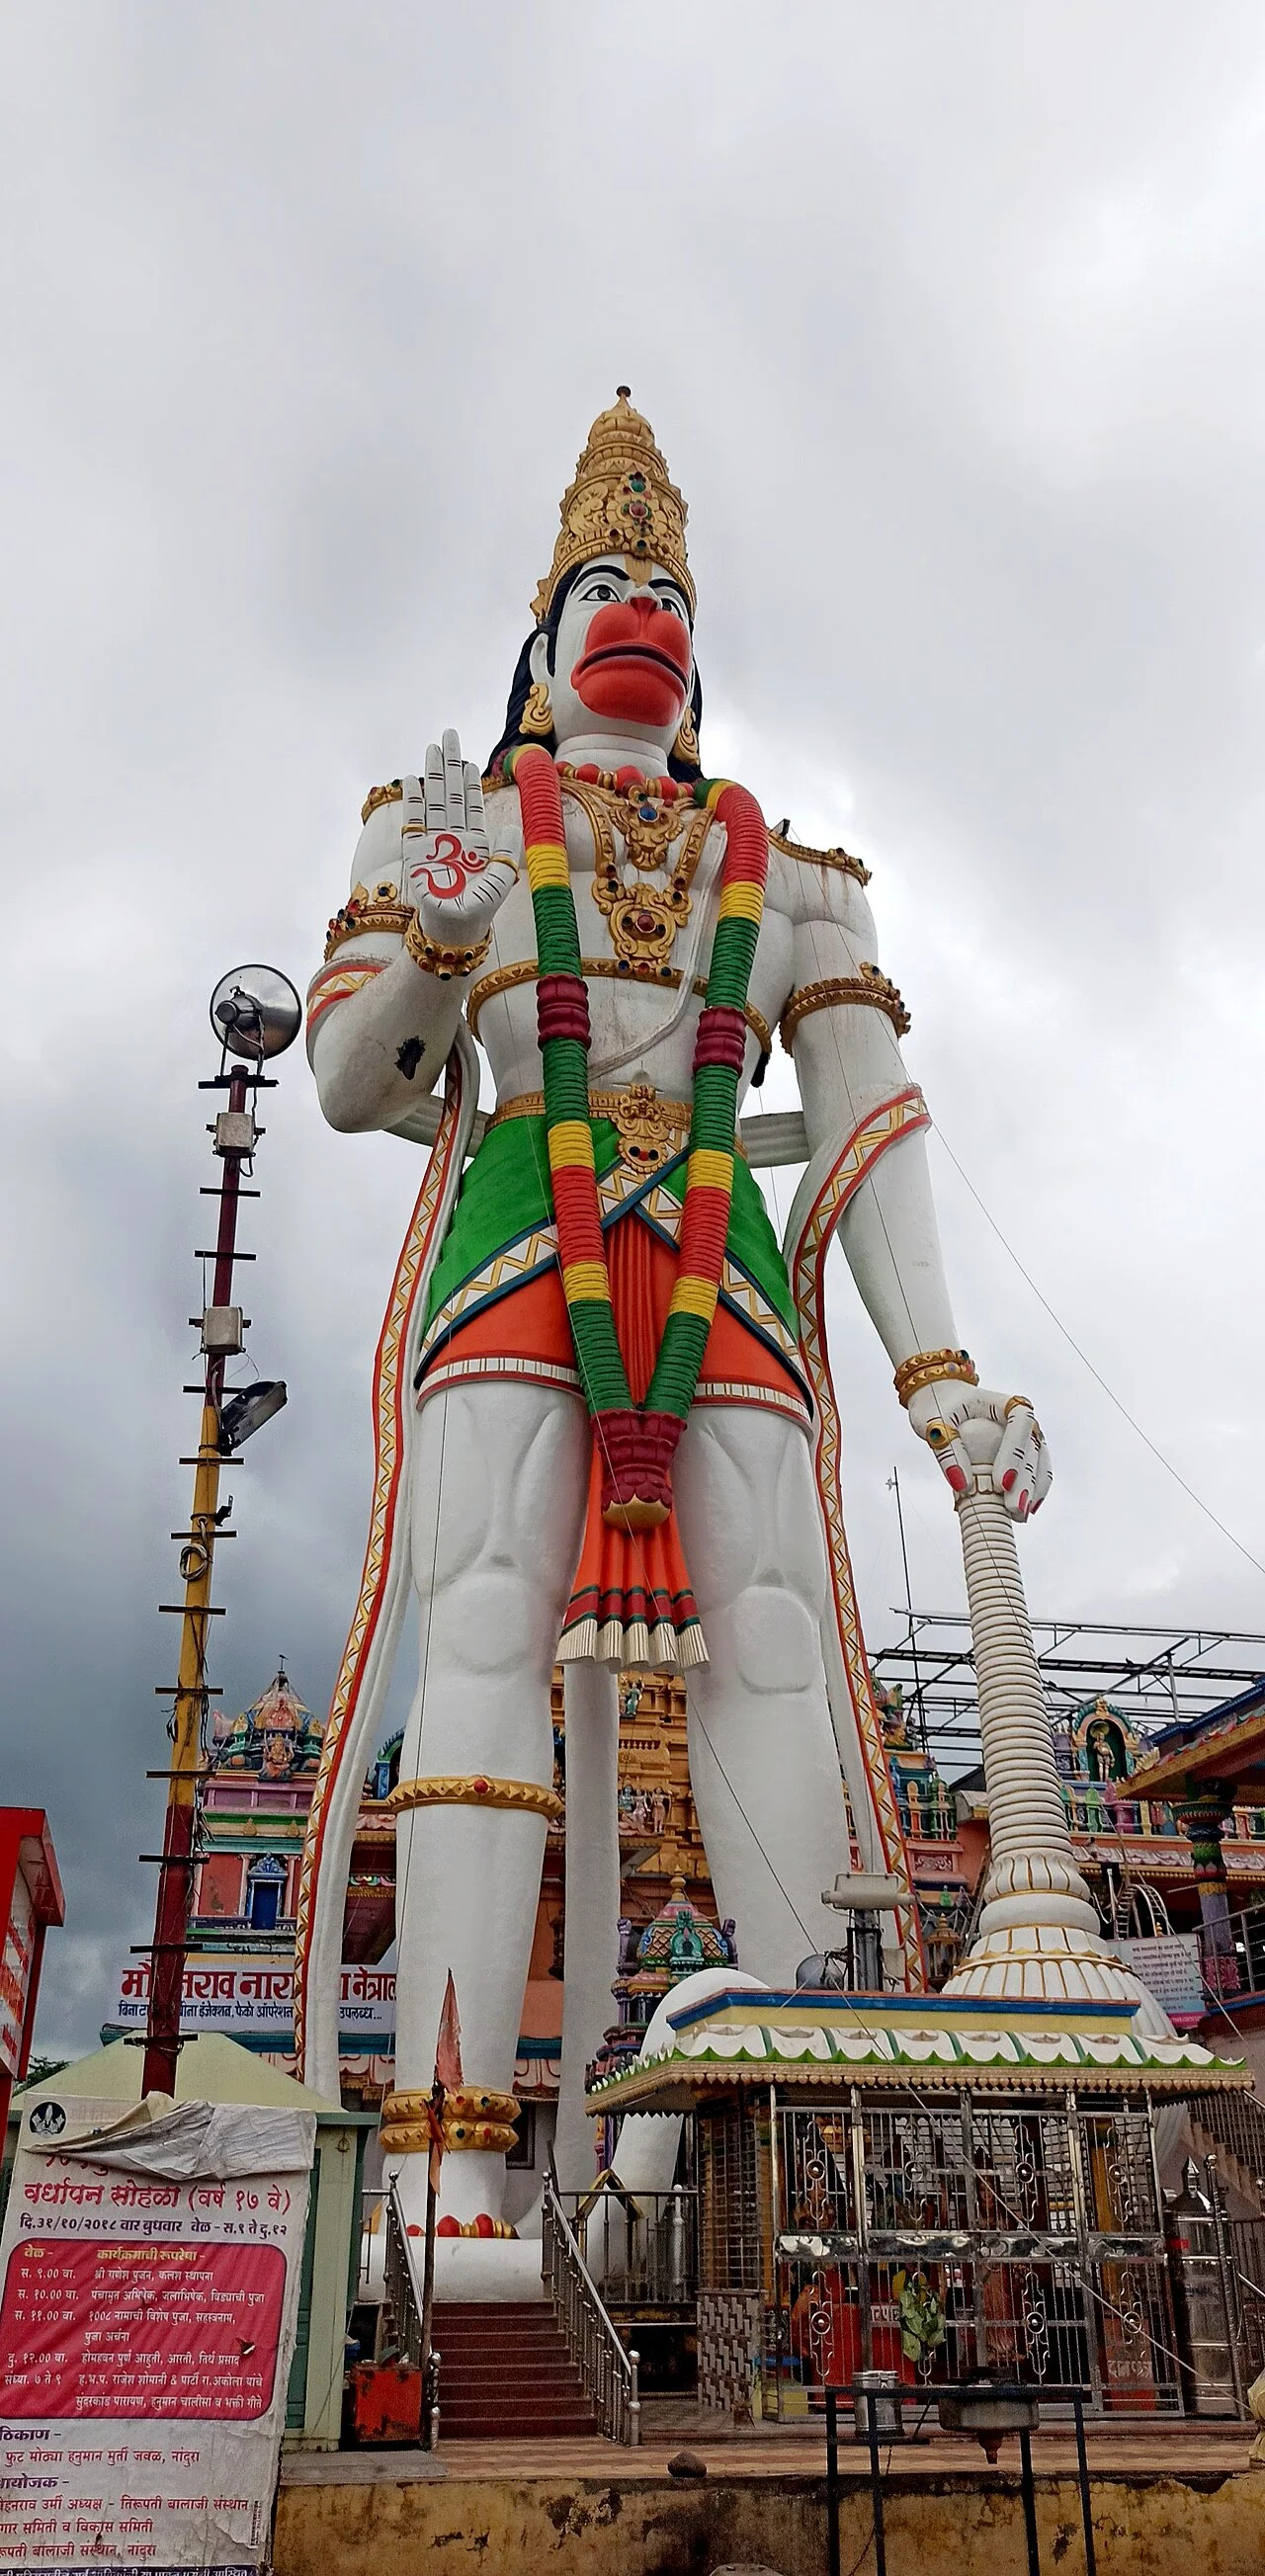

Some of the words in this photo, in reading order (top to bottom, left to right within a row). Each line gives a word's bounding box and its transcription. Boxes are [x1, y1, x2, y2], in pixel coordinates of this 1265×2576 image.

[24, 2178, 104, 2205] वर्धापन
[111, 2179, 182, 2209] सोहळा
[188, 2180, 226, 2212] (वर्ष
[235, 2190, 259, 2212] १७
[268, 2185, 292, 2215] वे)
[120, 2219, 140, 2232] वार
[142, 2218, 183, 2236] बुधवार
[191, 2217, 212, 2233] वेळ
[248, 2218, 258, 2236] ते
[25, 2244, 45, 2259] वेळ
[97, 2246, 158, 2260] कार्यक्रमाची
[21, 2268, 32, 2279] स.
[62, 2269, 76, 2279] वा.
[95, 2266, 106, 2280] श्री
[108, 2267, 129, 2280] गणेश
[158, 2271, 182, 2281] कलश
[185, 2270, 213, 2282] स्थापना
[18, 2288, 29, 2299] स.
[65, 2289, 79, 2300] वा.
[91, 2286, 120, 2304] पंचामृत
[123, 2287, 158, 2301] अभिषेक,
[162, 2287, 207, 2303] जलाभिषेक,
[247, 2292, 265, 2306] पुजा
[15, 2310, 26, 2321] स.
[62, 2310, 76, 2321] वा.
[114, 2309, 143, 2322] नामाची
[146, 2308, 169, 2322] विशेष
[172, 2313, 192, 2326] पुजा,
[84, 2332, 102, 2345] पुजा
[8, 2354, 18, 2368] दु.
[54, 2354, 68, 2364] वा.
[117, 2349, 131, 2368] पुर्ण
[135, 2351, 163, 2368] आहुती,
[168, 2352, 195, 2366] आरती,
[199, 2351, 216, 2365] तिर्थ
[218, 2355, 240, 2367] प्रसाद
[35, 2374, 42, 2384] ७
[44, 2370, 51, 2384] ते
[55, 2373, 61, 2384] ९
[113, 2371, 135, 2385] राजेश
[170, 2374, 177, 2385] &
[181, 2371, 200, 2386] पार्टी
[76, 2391, 111, 2410] सुंदरकांड
[114, 2395, 147, 2408] पारायण,
[151, 2395, 178, 2411] हनुमान
[180, 2393, 211, 2407] चालीसा
[215, 2397, 222, 2407] व
[247, 2394, 262, 2409] गीते
[5, 2451, 25, 2467] फुट
[30, 2446, 63, 2462] मोठ्या
[68, 2451, 103, 2466] हनुमान
[107, 2446, 128, 2466] मुर्ती
[133, 2451, 166, 2463] जवळ,
[172, 2447, 200, 2467] नांदुरा
[68, 2498, 103, 2511] अध्यक्ष
[120, 2494, 163, 2510] तिरूपती
[167, 2496, 209, 2510] बालाजी
[213, 2495, 249, 2510] संस्थान
[23, 2518, 57, 2534] समिती
[62, 2522, 70, 2533] व
[76, 2518, 114, 2533] विकास
[119, 2517, 153, 2534] समिती
[33, 2541, 74, 2557] बालाजी
[127, 2540, 156, 2561] नांदुरा
